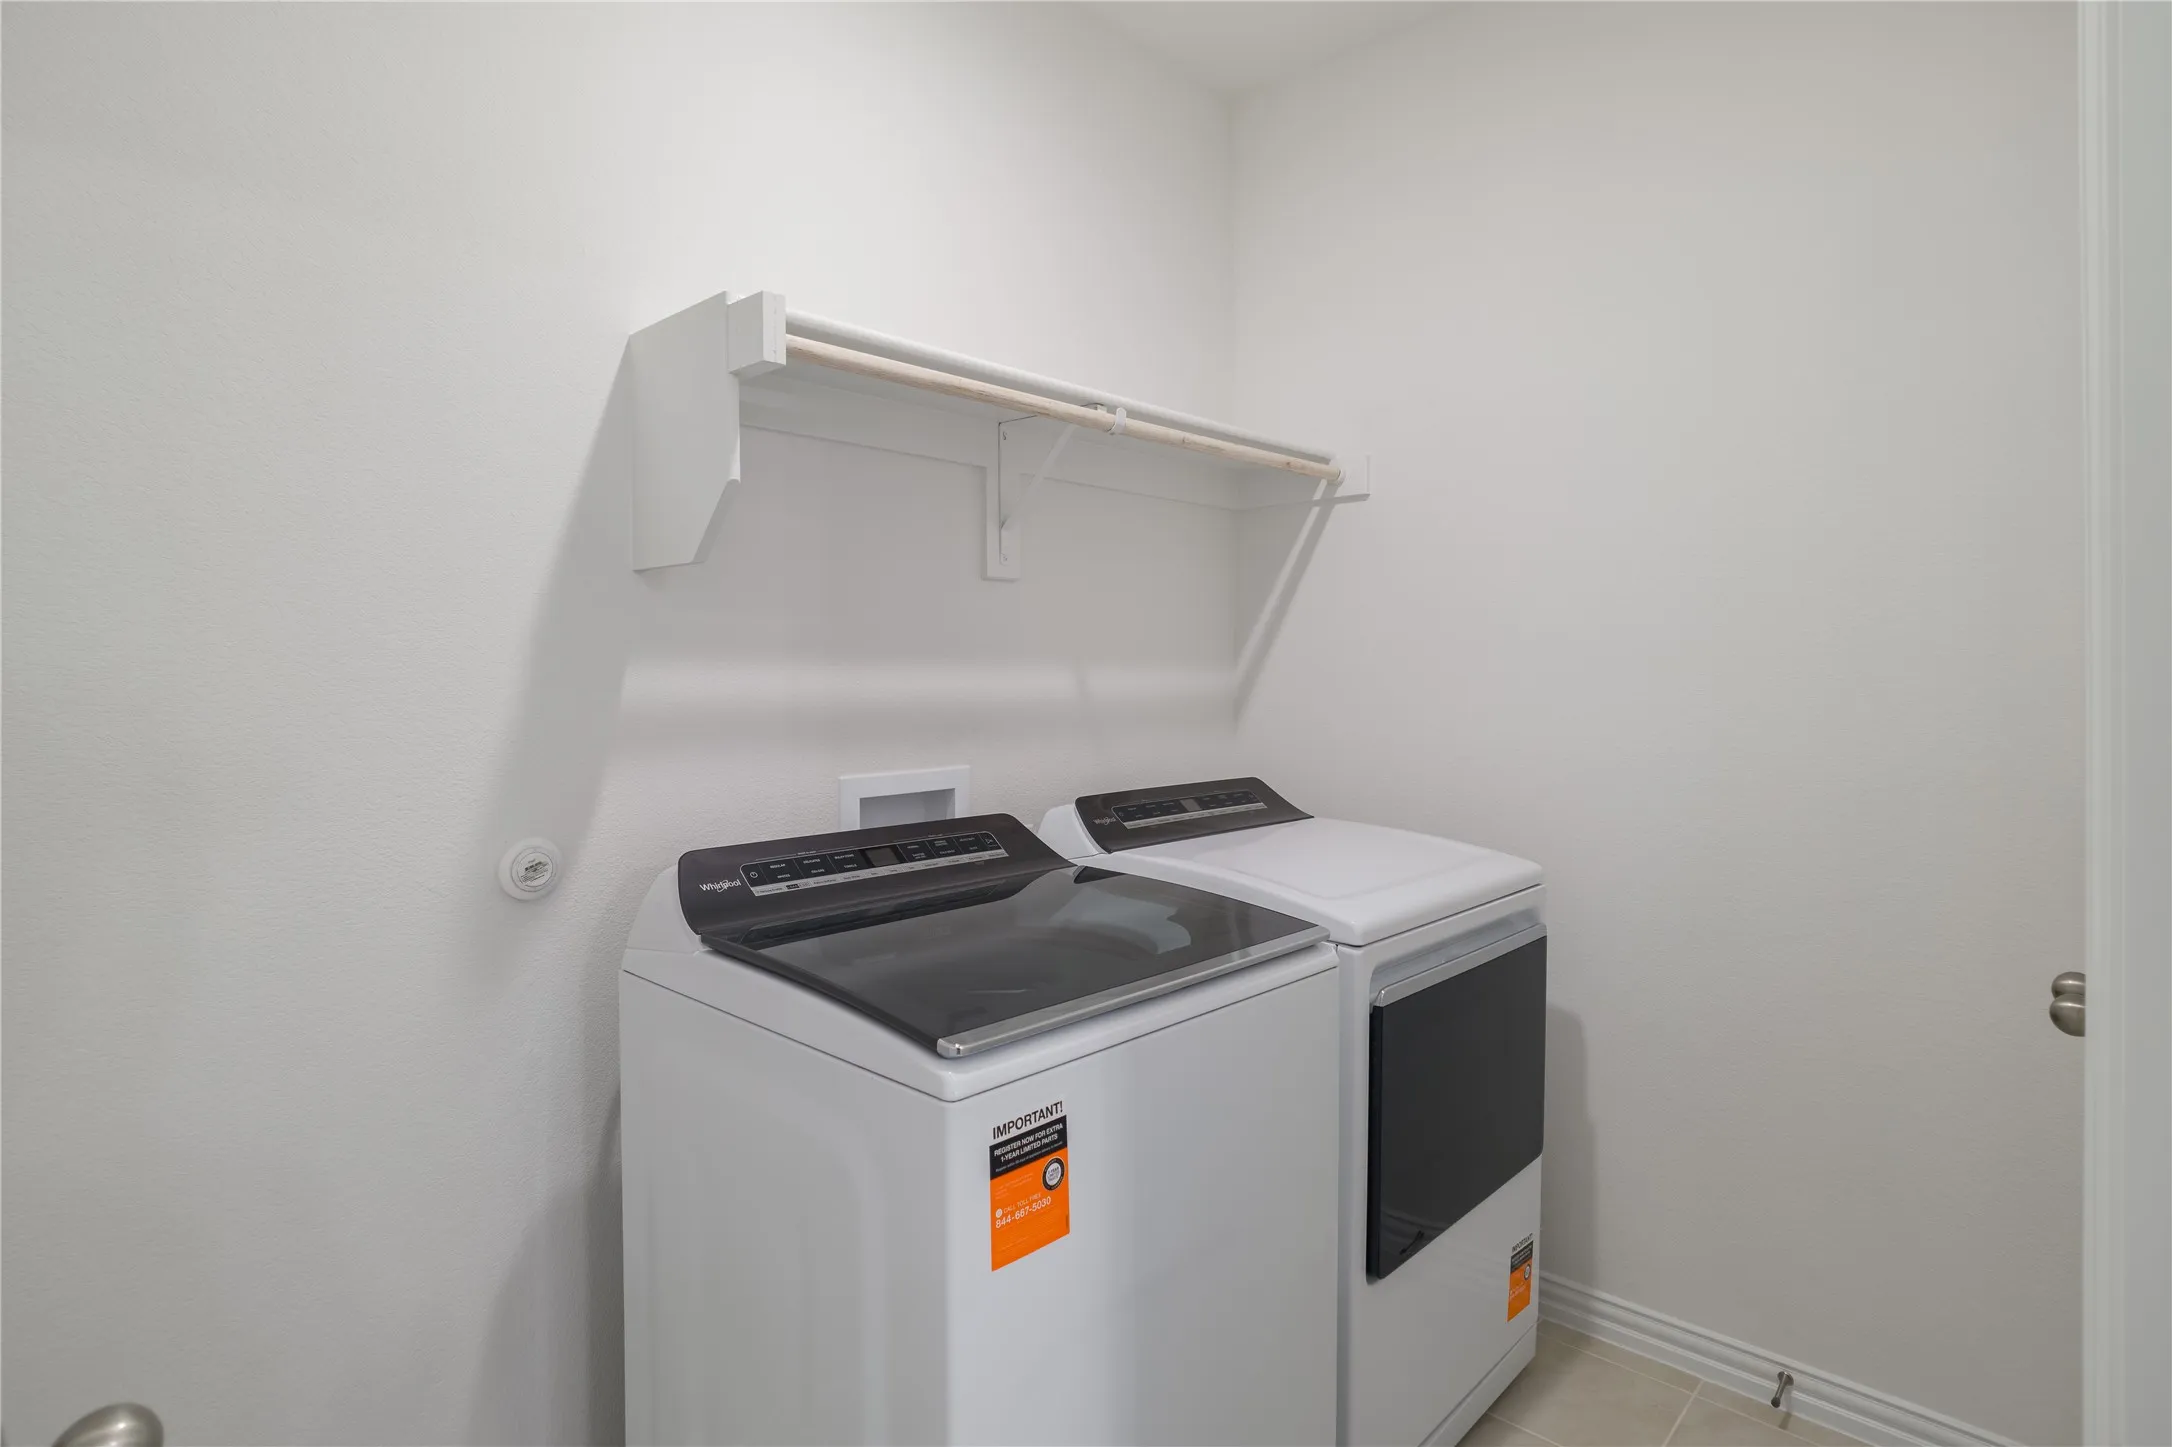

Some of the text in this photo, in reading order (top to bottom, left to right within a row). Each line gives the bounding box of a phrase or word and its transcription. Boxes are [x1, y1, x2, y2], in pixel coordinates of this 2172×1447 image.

[699, 878, 741, 893] Whirlpool
[992, 1100, 1063, 1140] IMPORTANT!
[994, 1123, 1063, 1157] REGISTER NOW FOR EXTRA
[1001, 1149, 1020, 1163] 1-YEAR
[1020, 1140, 1041, 1155] LIMITED
[1041, 1133, 1058, 1146] PARTS
[1003, 1204, 1016, 1213] CALL
[1017, 1198, 1028, 1208] TOLL
